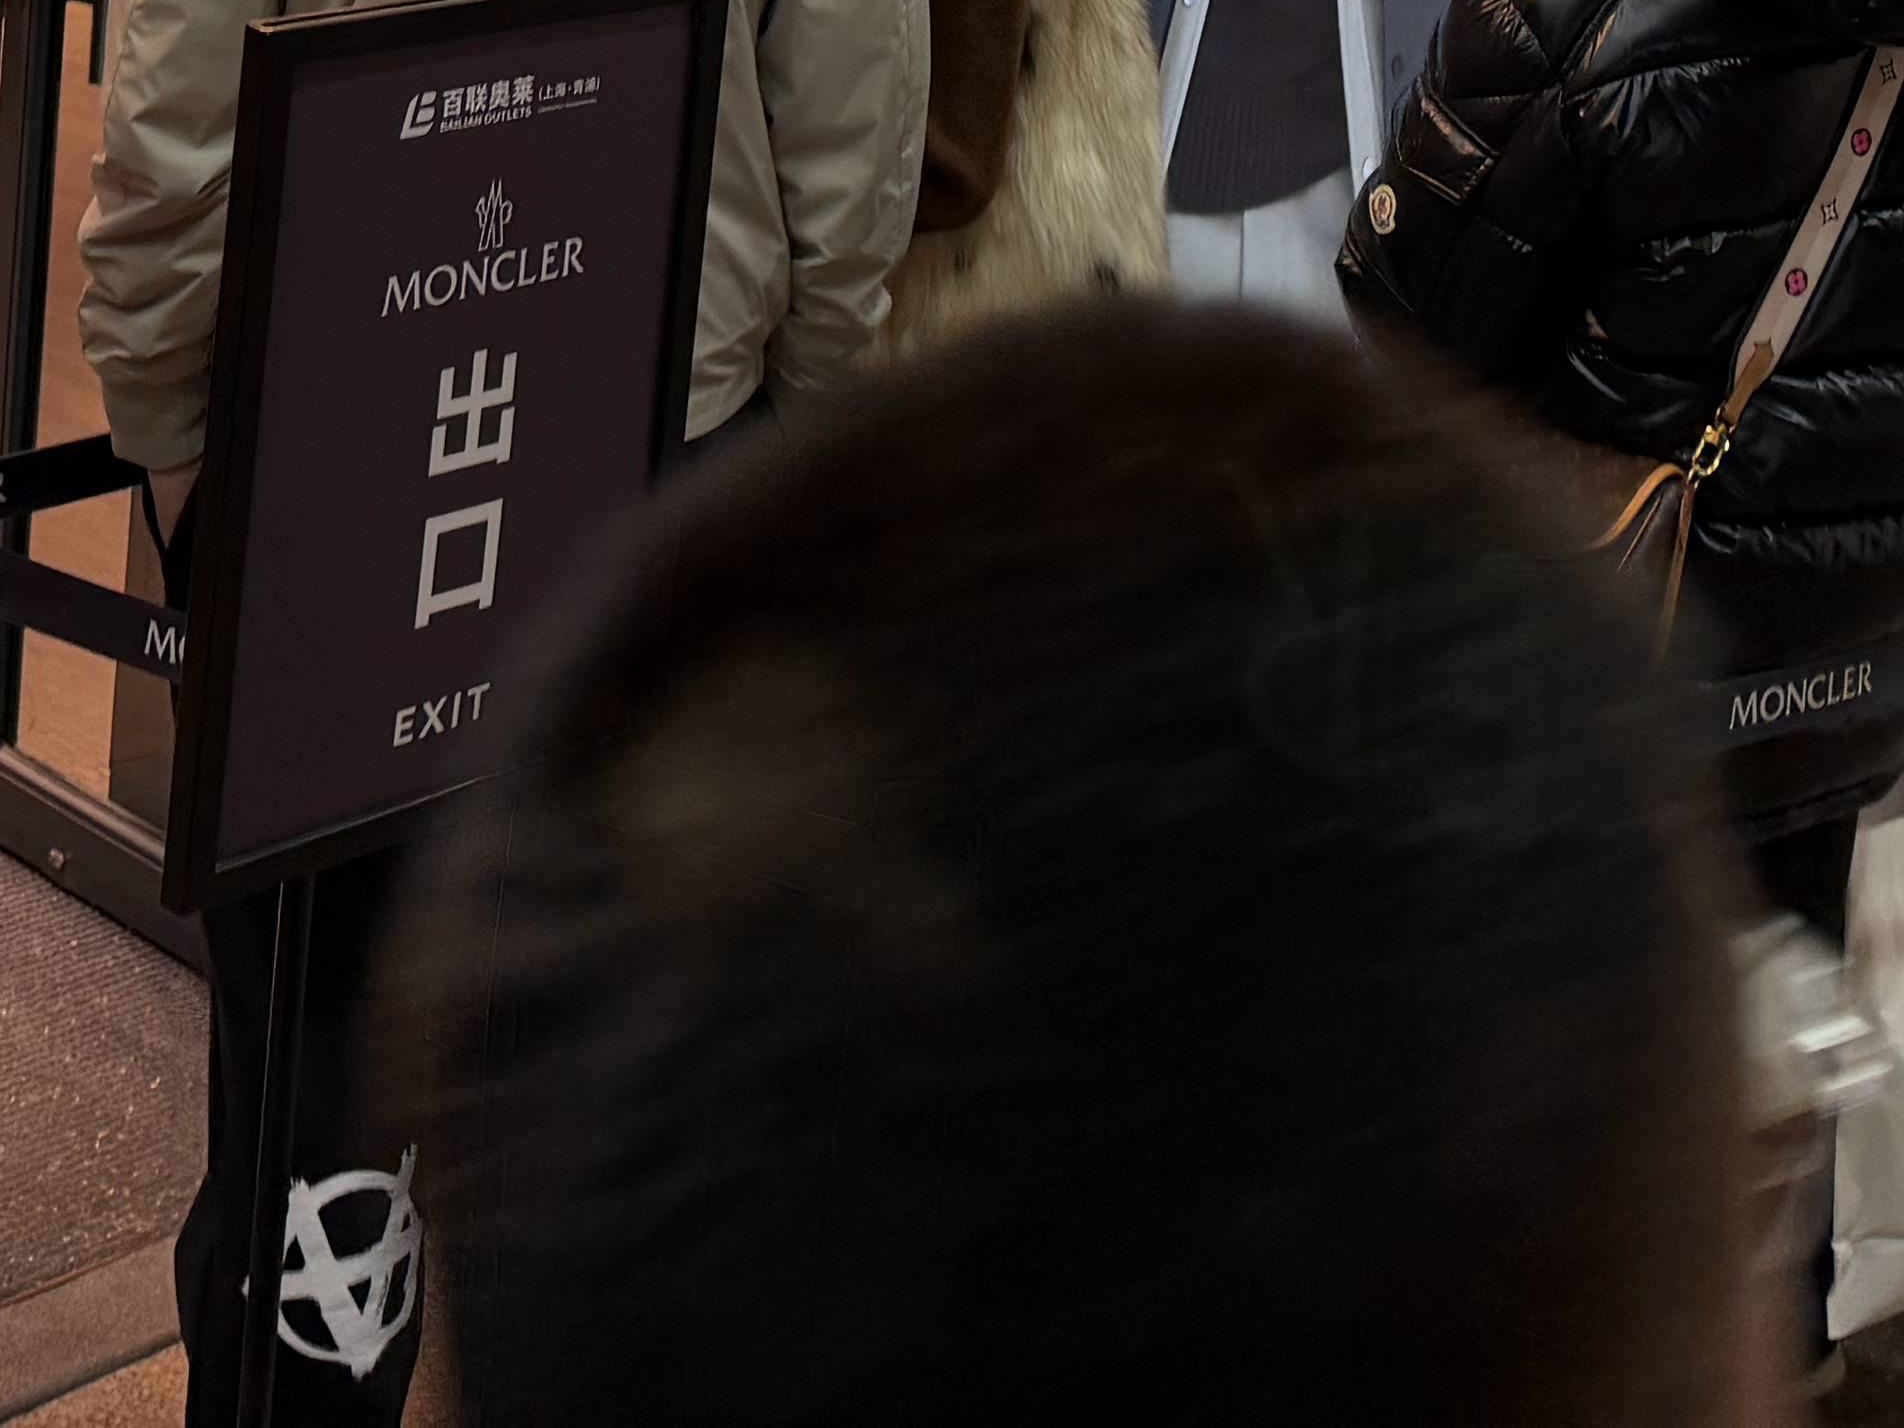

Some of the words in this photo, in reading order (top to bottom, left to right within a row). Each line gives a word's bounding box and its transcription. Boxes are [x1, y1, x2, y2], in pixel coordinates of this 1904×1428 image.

[380, 236, 585, 318] MONCLER
[414, 348, 518, 630] 出口
[393, 682, 491, 747] EXIT
[1728, 660, 1873, 731] MONCLER
